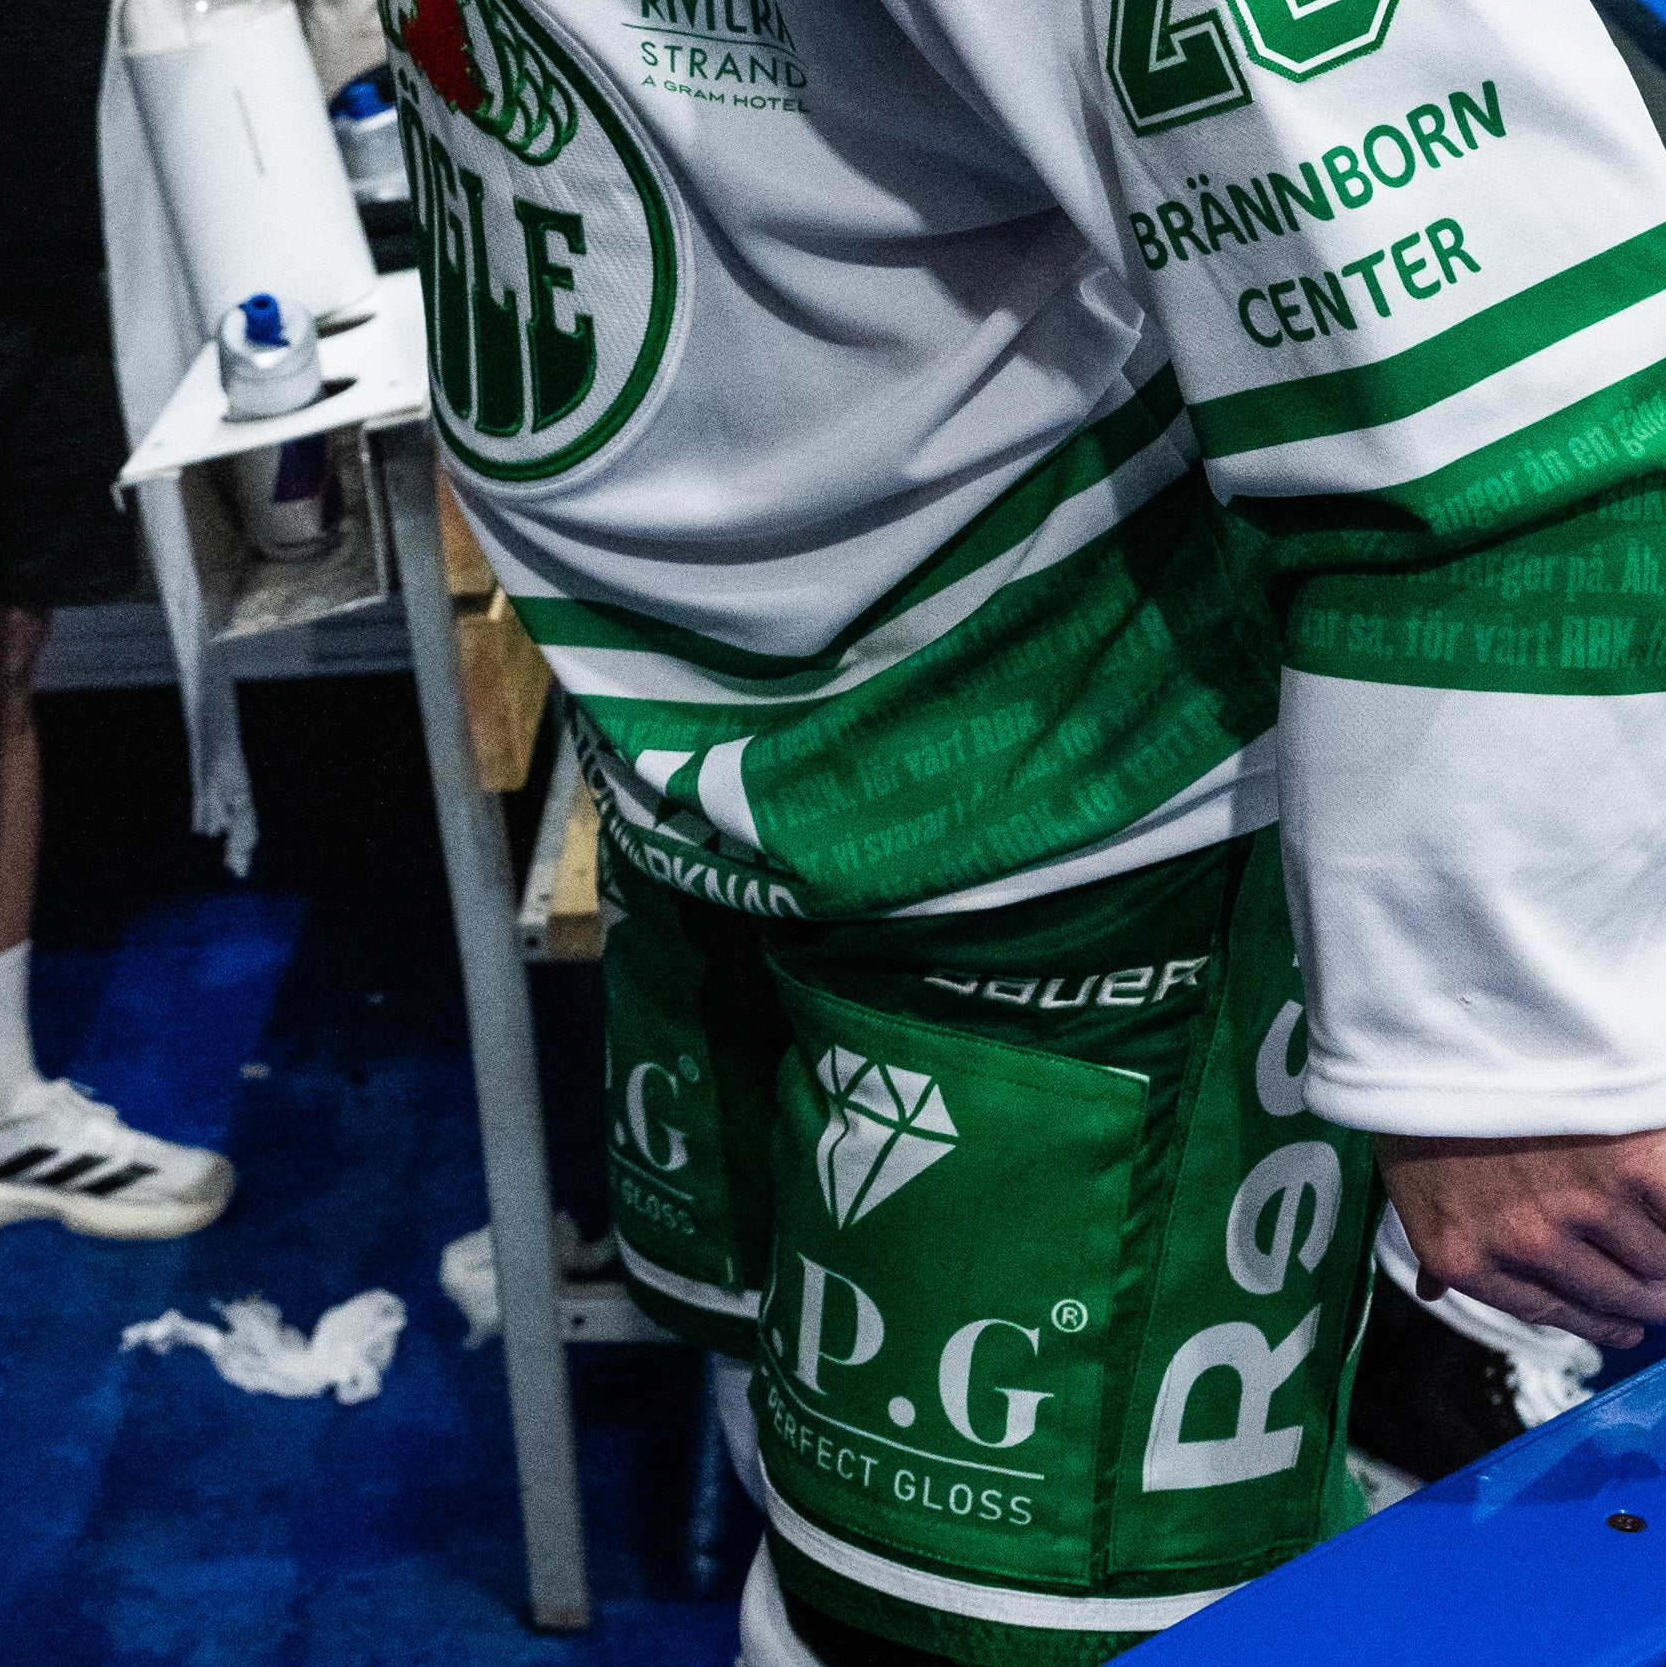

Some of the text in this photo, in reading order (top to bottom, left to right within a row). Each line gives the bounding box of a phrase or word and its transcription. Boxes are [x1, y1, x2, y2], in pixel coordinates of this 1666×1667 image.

[639, 39, 809, 91] STRAND
[641, 74, 812, 115] A GRAM HOTEL
[1132, 80, 1508, 271] BRÄNNBORN
[1237, 217, 1482, 349] CENTER
[893, 1456, 1035, 1527] GLOSS
